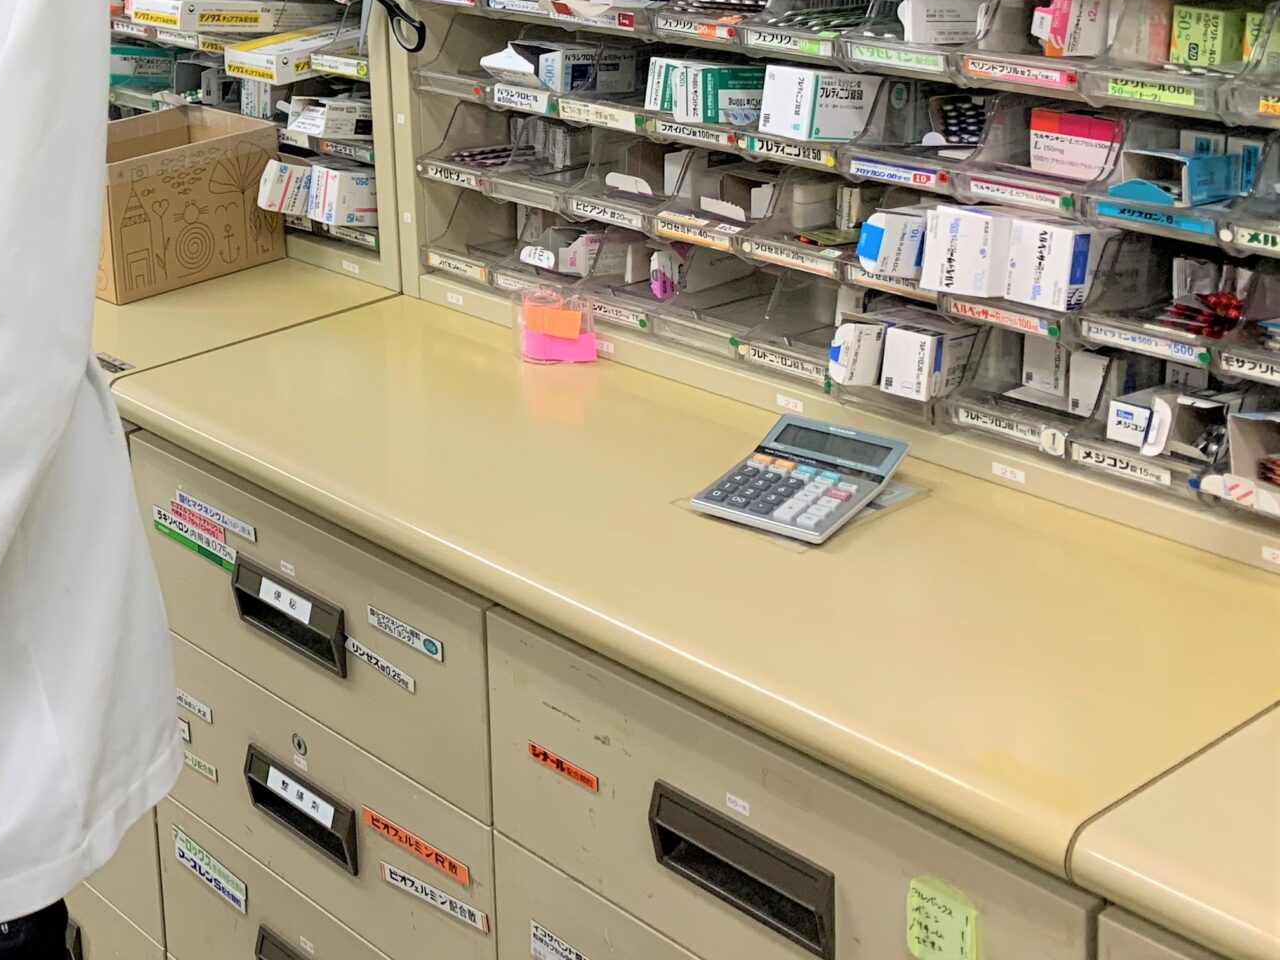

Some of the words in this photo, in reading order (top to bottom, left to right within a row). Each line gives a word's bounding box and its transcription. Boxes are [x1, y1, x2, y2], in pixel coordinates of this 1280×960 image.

[1082, 450, 1129, 470] メジコン
[389, 869, 477, 924] ビオフェルミン配合散
